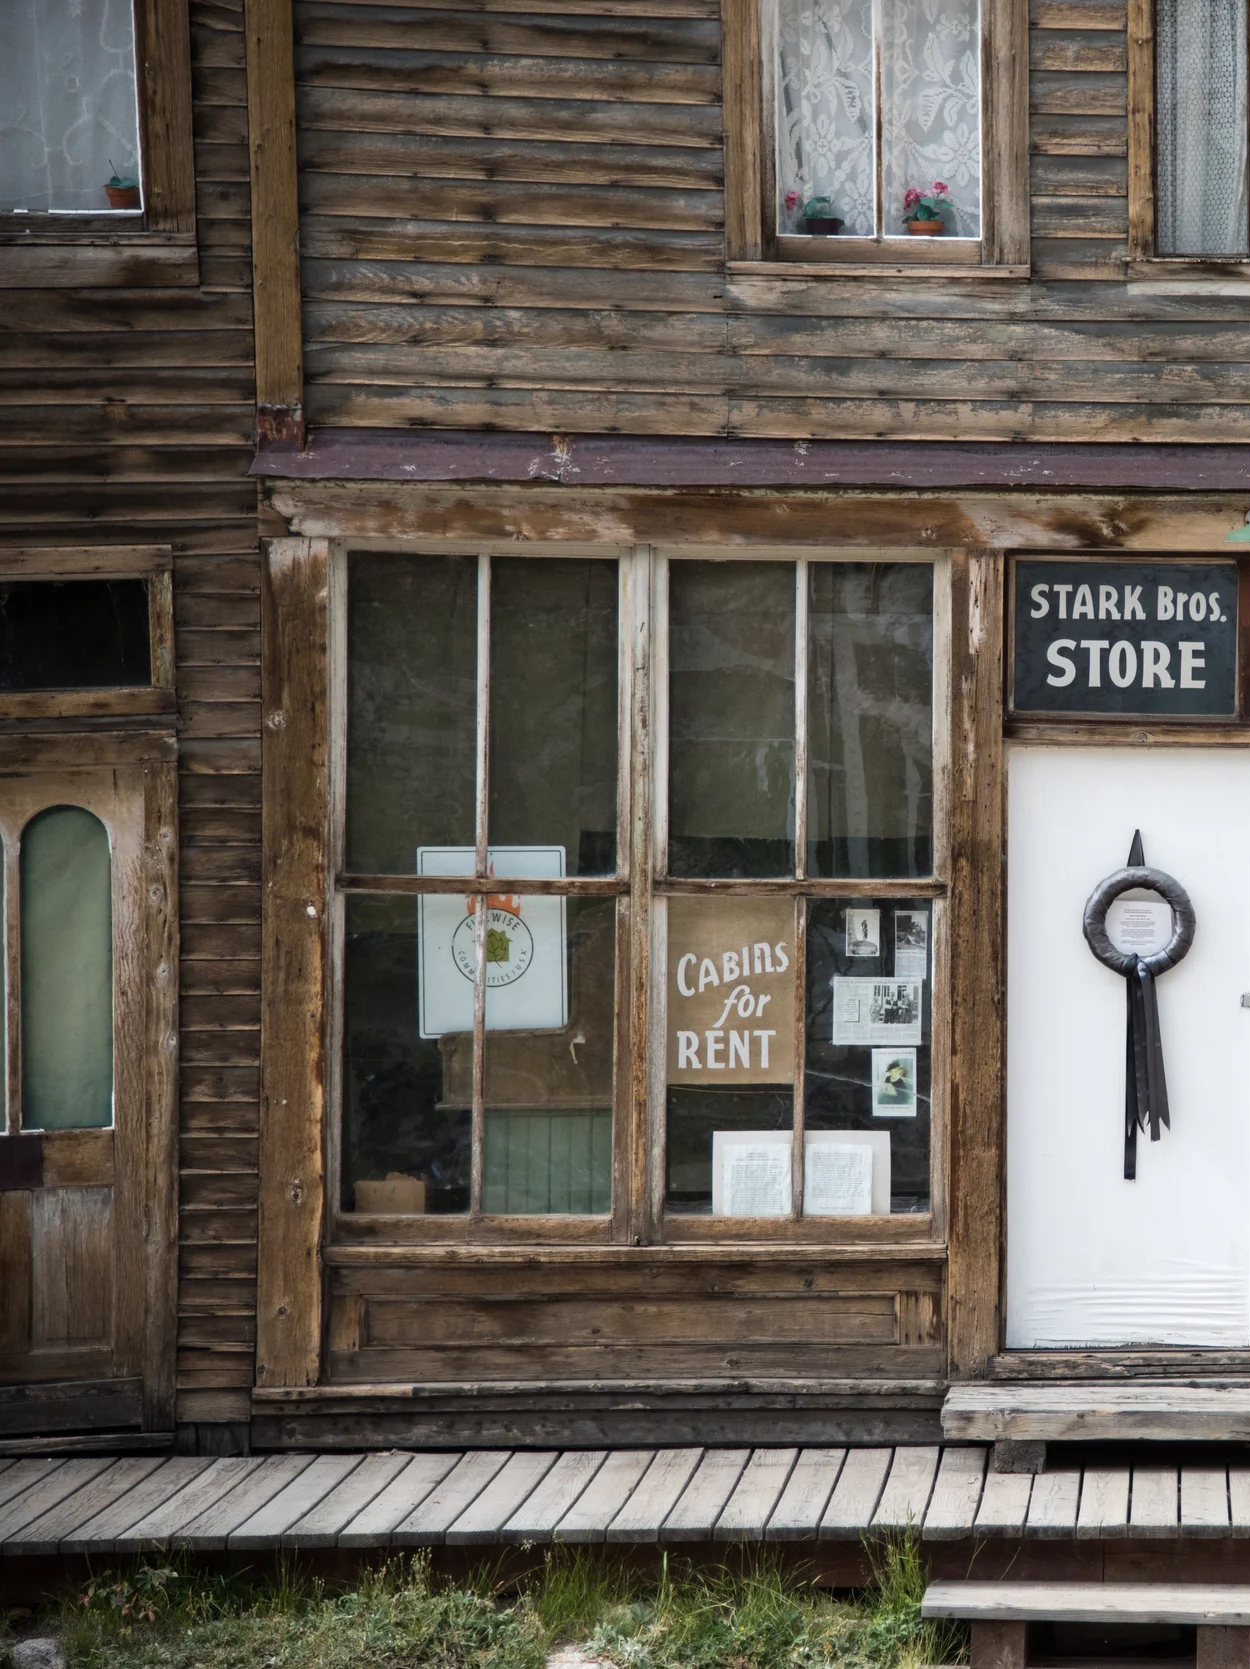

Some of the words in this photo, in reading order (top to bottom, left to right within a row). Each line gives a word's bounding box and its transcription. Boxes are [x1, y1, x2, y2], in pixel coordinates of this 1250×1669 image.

[1030, 583, 1147, 621] STARK
[1156, 585, 1228, 624] Bros.
[1046, 638, 1207, 690] STORE
[711, 984, 772, 1028] for
[676, 1029, 777, 1069] RENT
